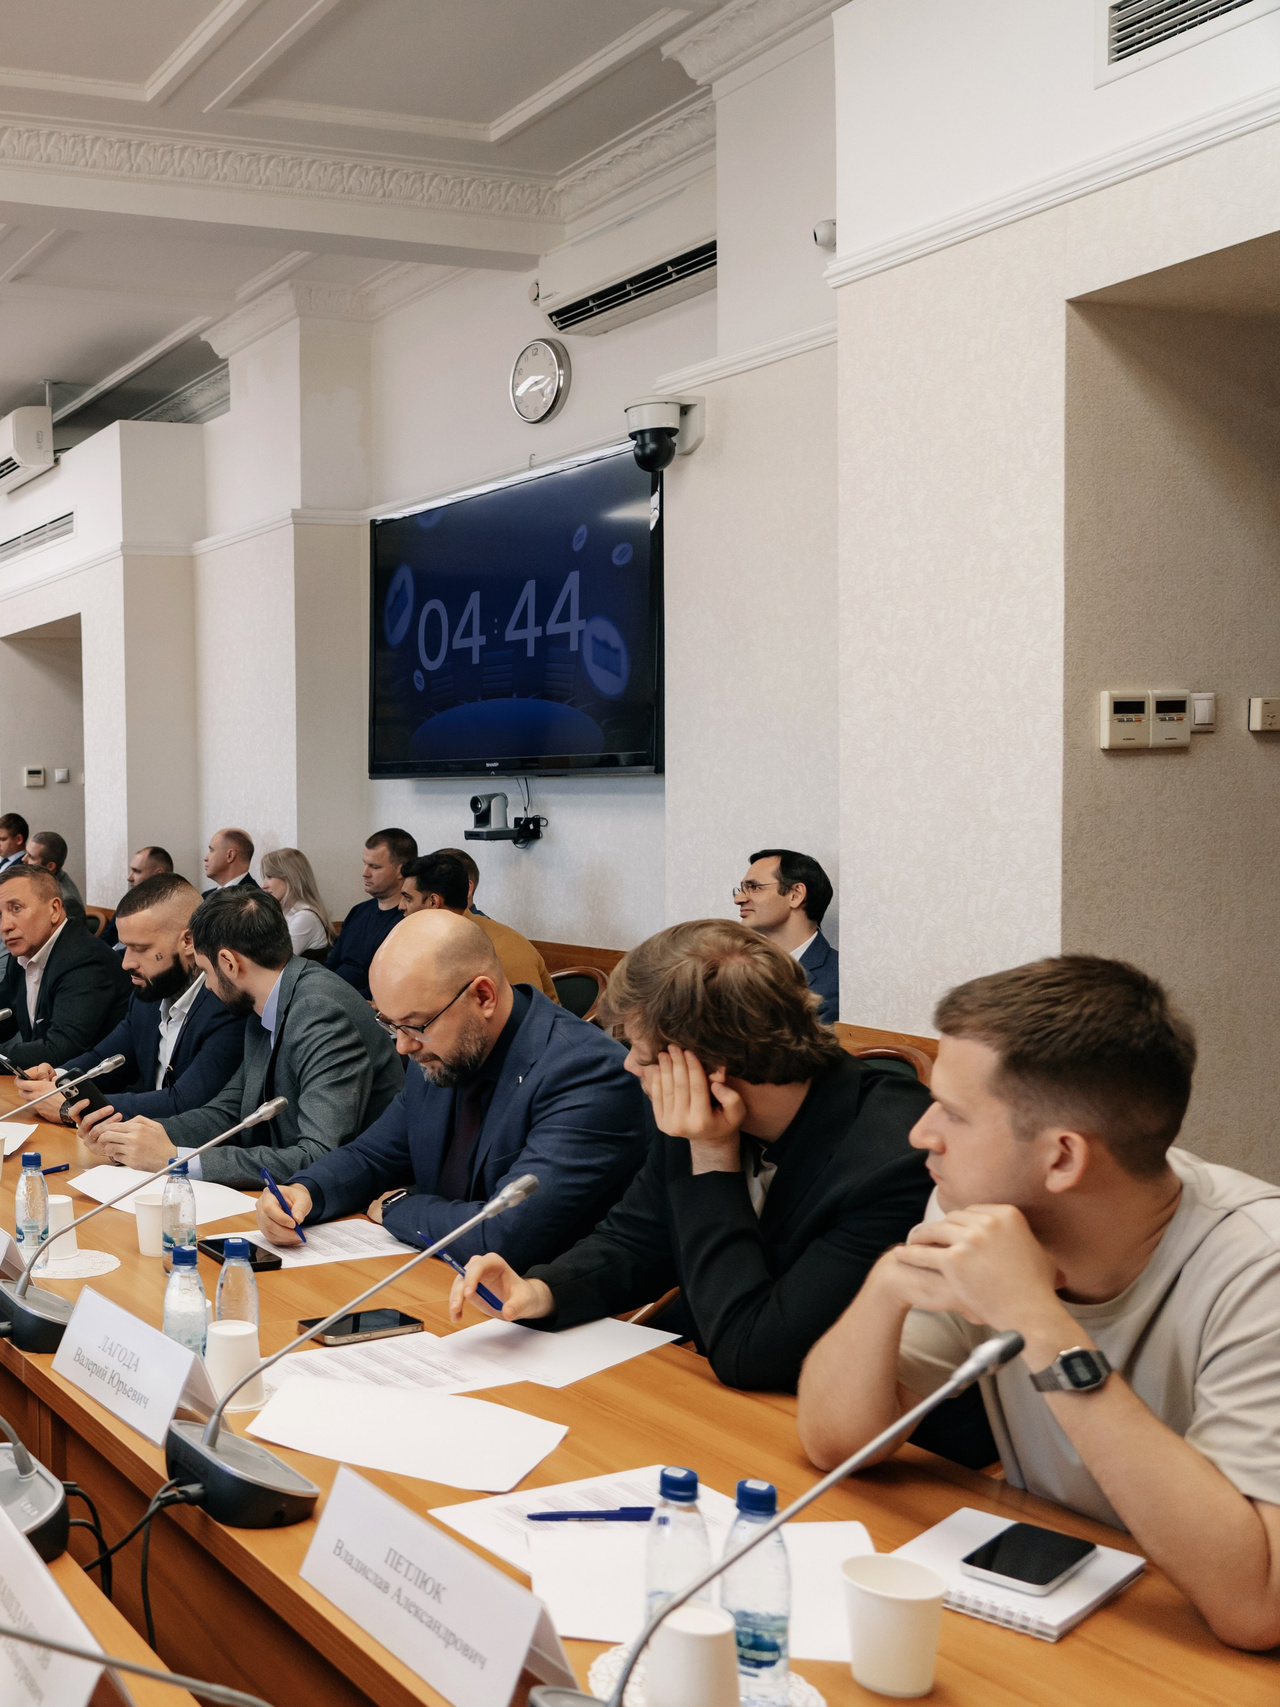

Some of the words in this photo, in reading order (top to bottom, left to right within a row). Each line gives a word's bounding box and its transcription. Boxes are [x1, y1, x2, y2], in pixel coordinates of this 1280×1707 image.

[417, 570, 586, 672] 04:44
[73, 1347, 109, 1382] Валерий
[107, 1370, 150, 1410] Юрьевич
[98, 1336, 141, 1373] ЛАГОДА
[332, 1539, 391, 1594] Владислав
[391, 1587, 488, 1671] Александрович
[383, 1547, 448, 1604] ПЕТЛЮК
